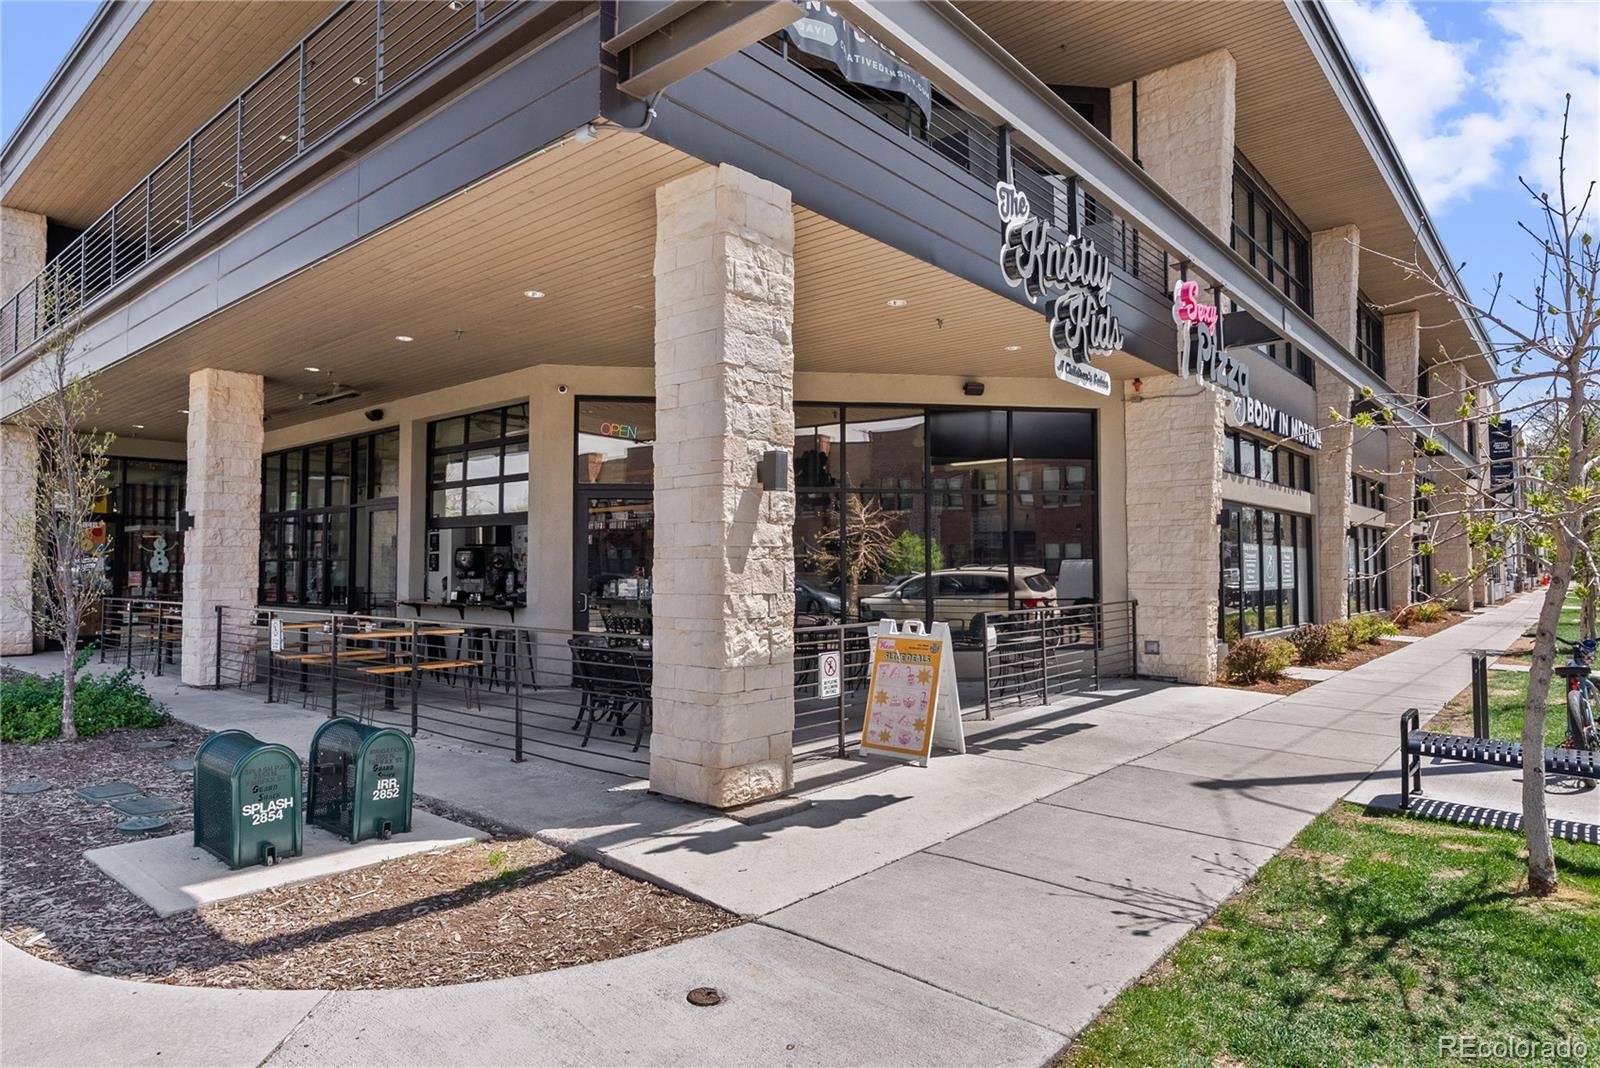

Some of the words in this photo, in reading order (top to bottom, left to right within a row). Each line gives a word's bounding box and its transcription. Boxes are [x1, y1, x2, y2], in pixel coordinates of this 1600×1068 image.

[999, 185, 1029, 217] The
[1008, 217, 1113, 306] Knotty
[1177, 280, 1218, 336] Sexy
[1058, 293, 1124, 362] Kids
[1195, 322, 1250, 399] Pizza
[600, 422, 637, 439] OPEN
[1247, 397, 1276, 432] BODY
[1279, 411, 1289, 436] IN
[1291, 417, 1322, 450] MOTION
[372, 787, 400, 800] 2852
[377, 778, 400, 790] IRR.
[242, 797, 294, 816] SPLASH
[252, 809, 284, 825] 2854
